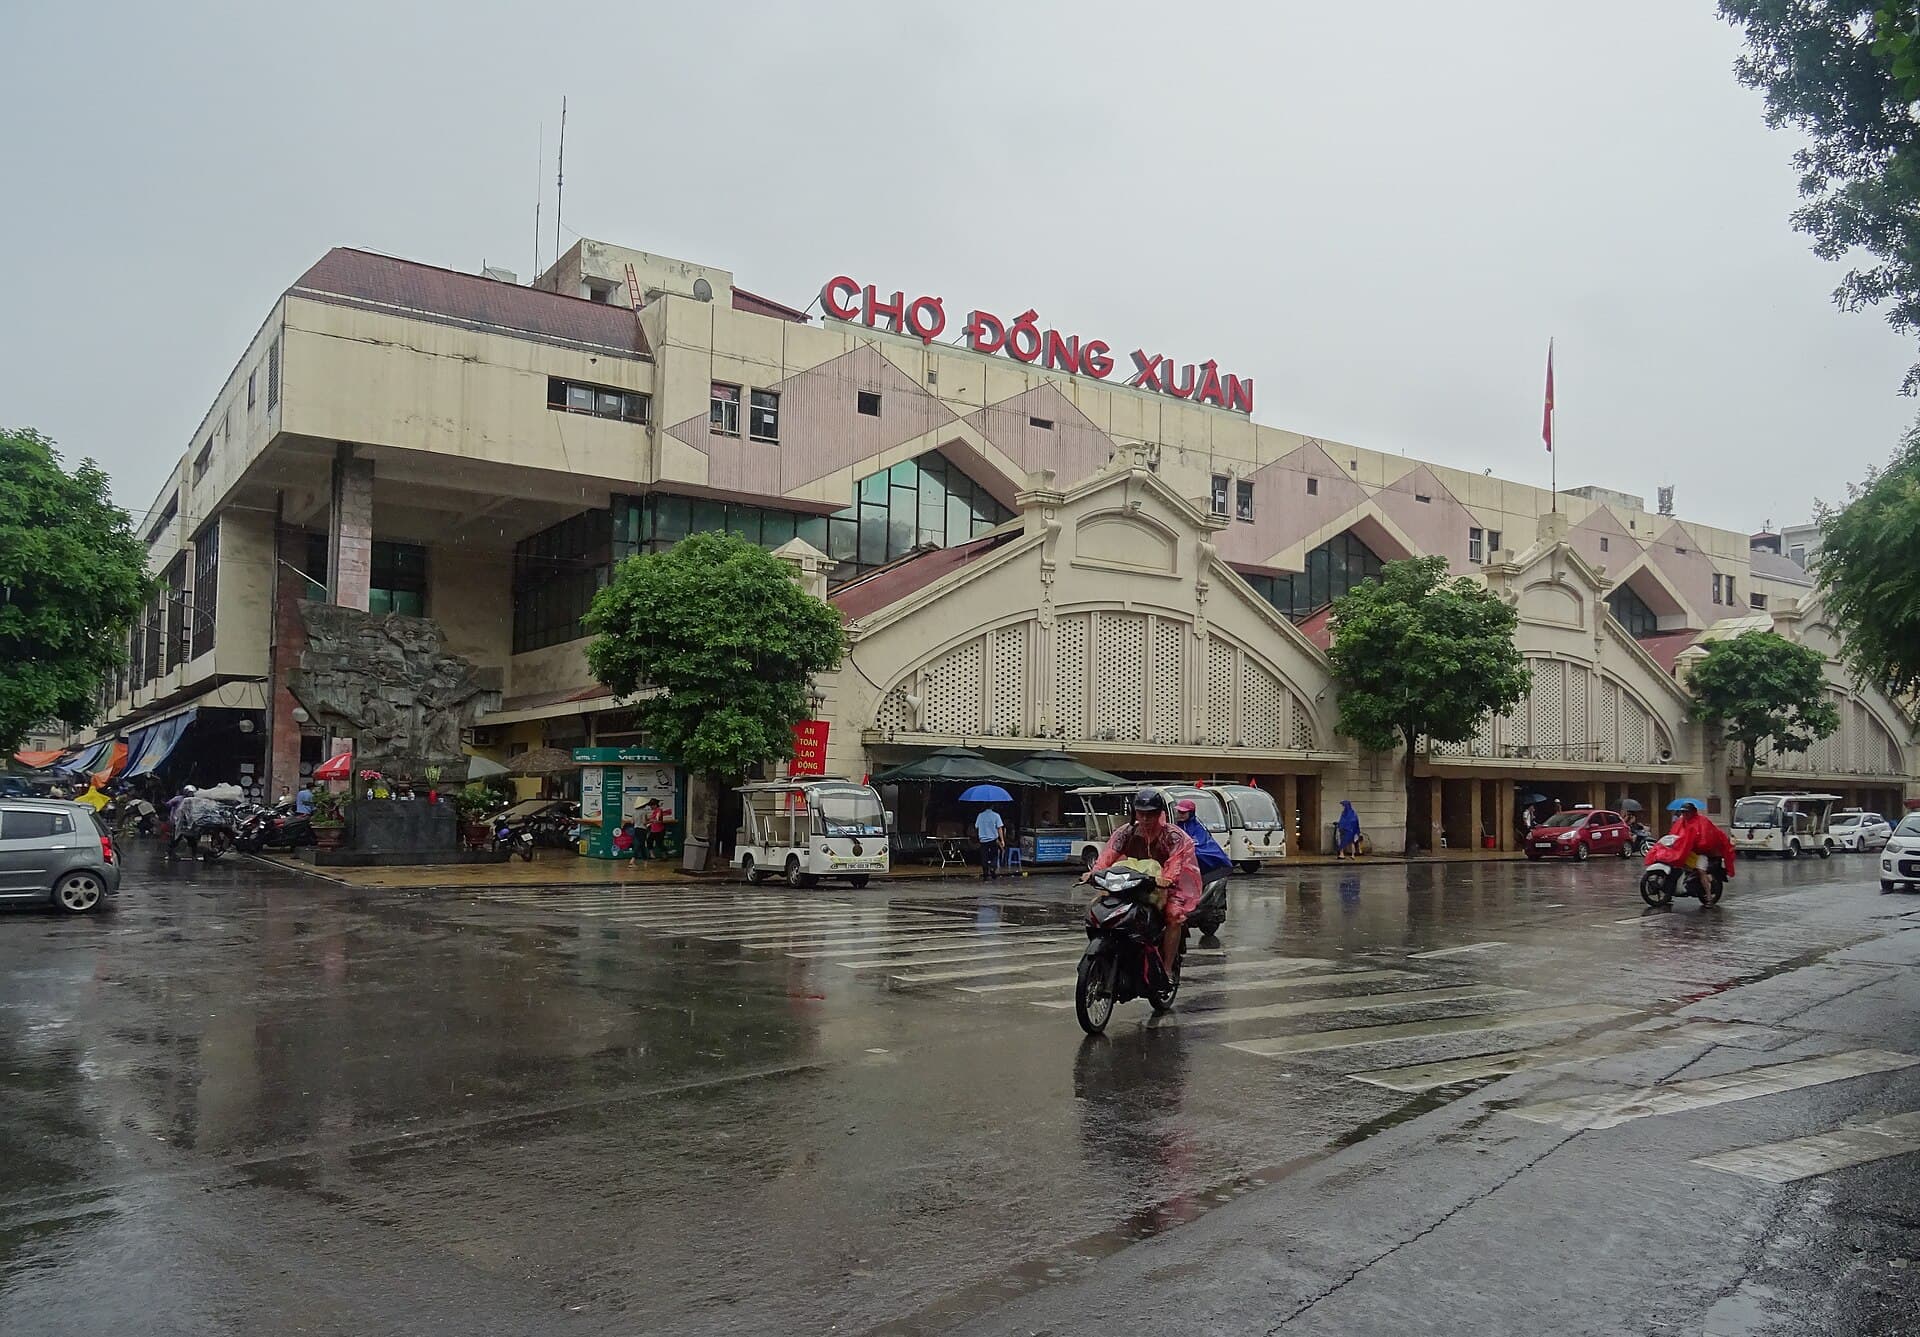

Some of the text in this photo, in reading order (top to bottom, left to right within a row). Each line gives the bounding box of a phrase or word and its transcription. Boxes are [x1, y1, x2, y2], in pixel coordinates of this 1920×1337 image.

[820, 275, 946, 346] CHỢ
[1129, 348, 1253, 413] XUÂN
[804, 727, 815, 735] AN
[800, 738, 818, 747] TOÀN
[800, 750, 815, 758] LAO
